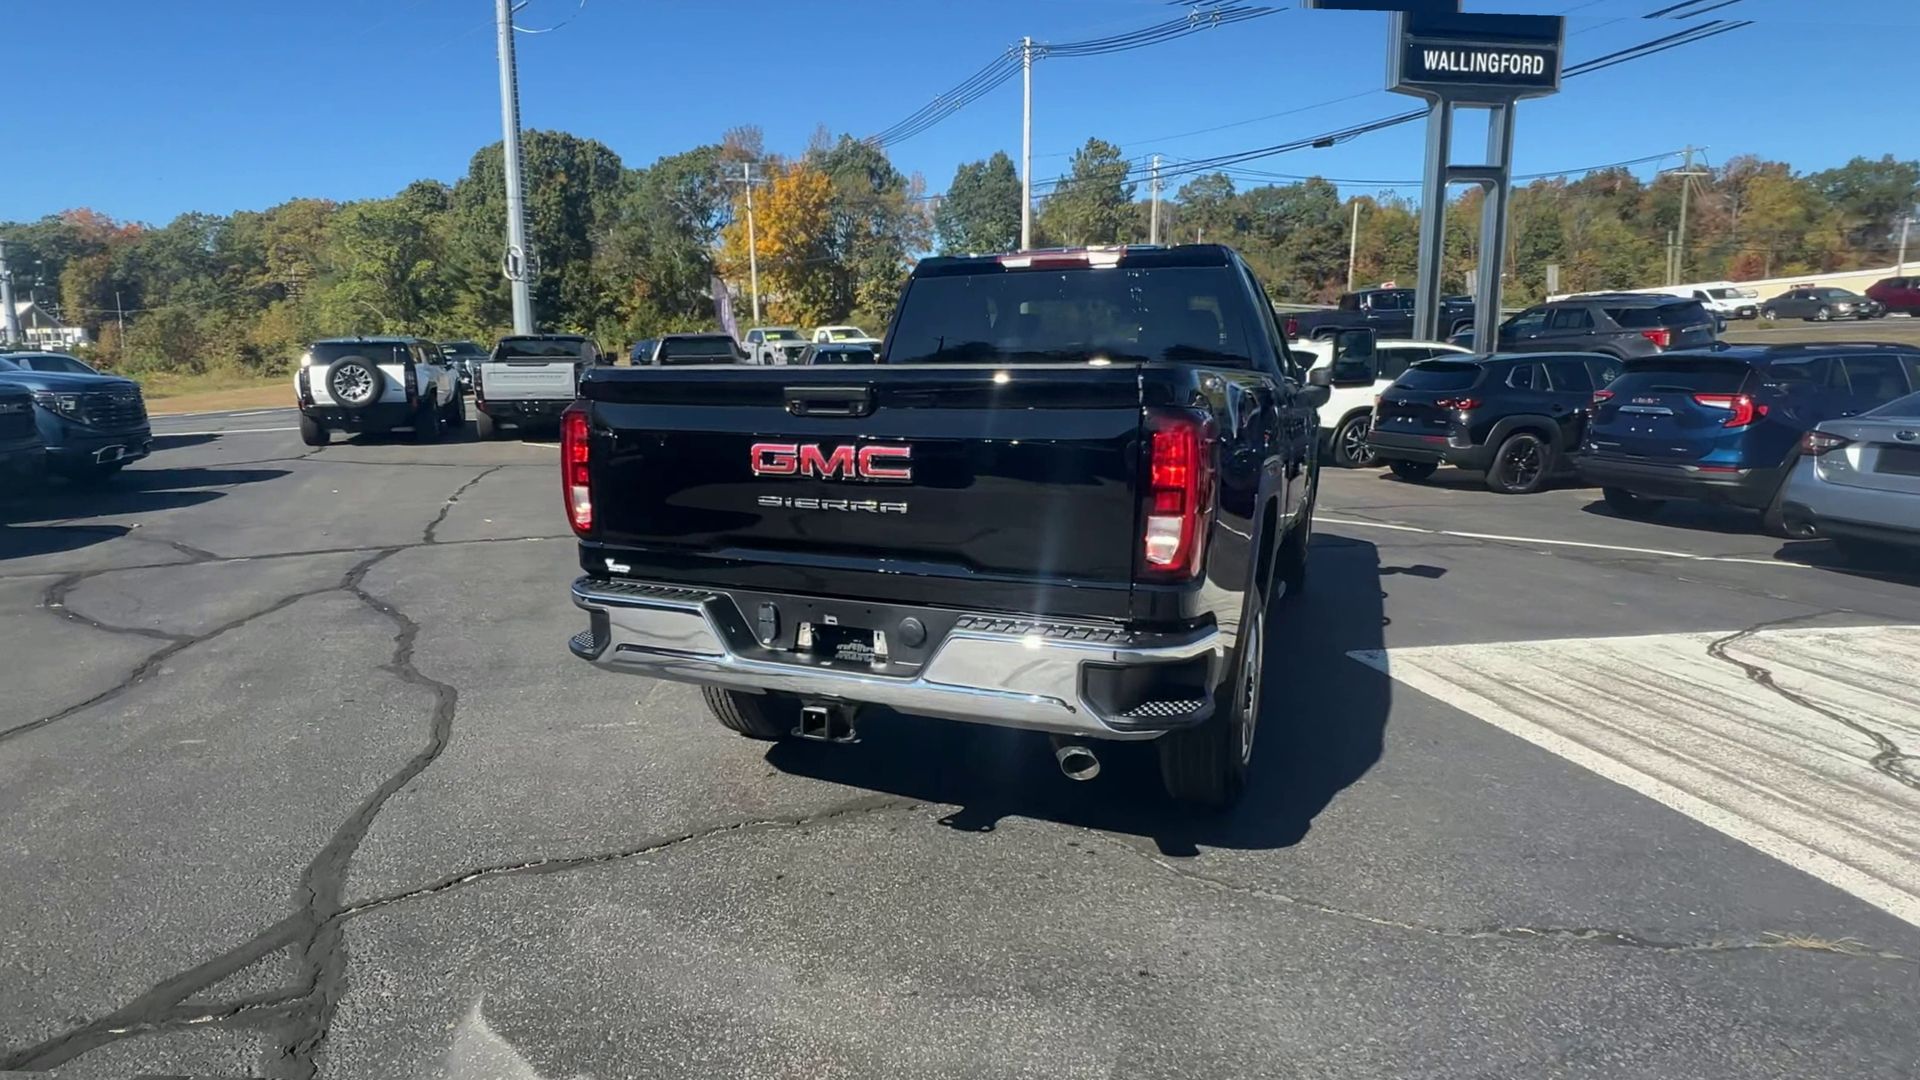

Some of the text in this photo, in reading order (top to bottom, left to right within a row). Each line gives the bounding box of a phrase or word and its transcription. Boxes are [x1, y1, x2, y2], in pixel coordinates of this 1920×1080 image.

[1423, 50, 1544, 75] WALLINGFORD
[751, 443, 911, 480] GMC
[757, 495, 908, 514] SIERRA
